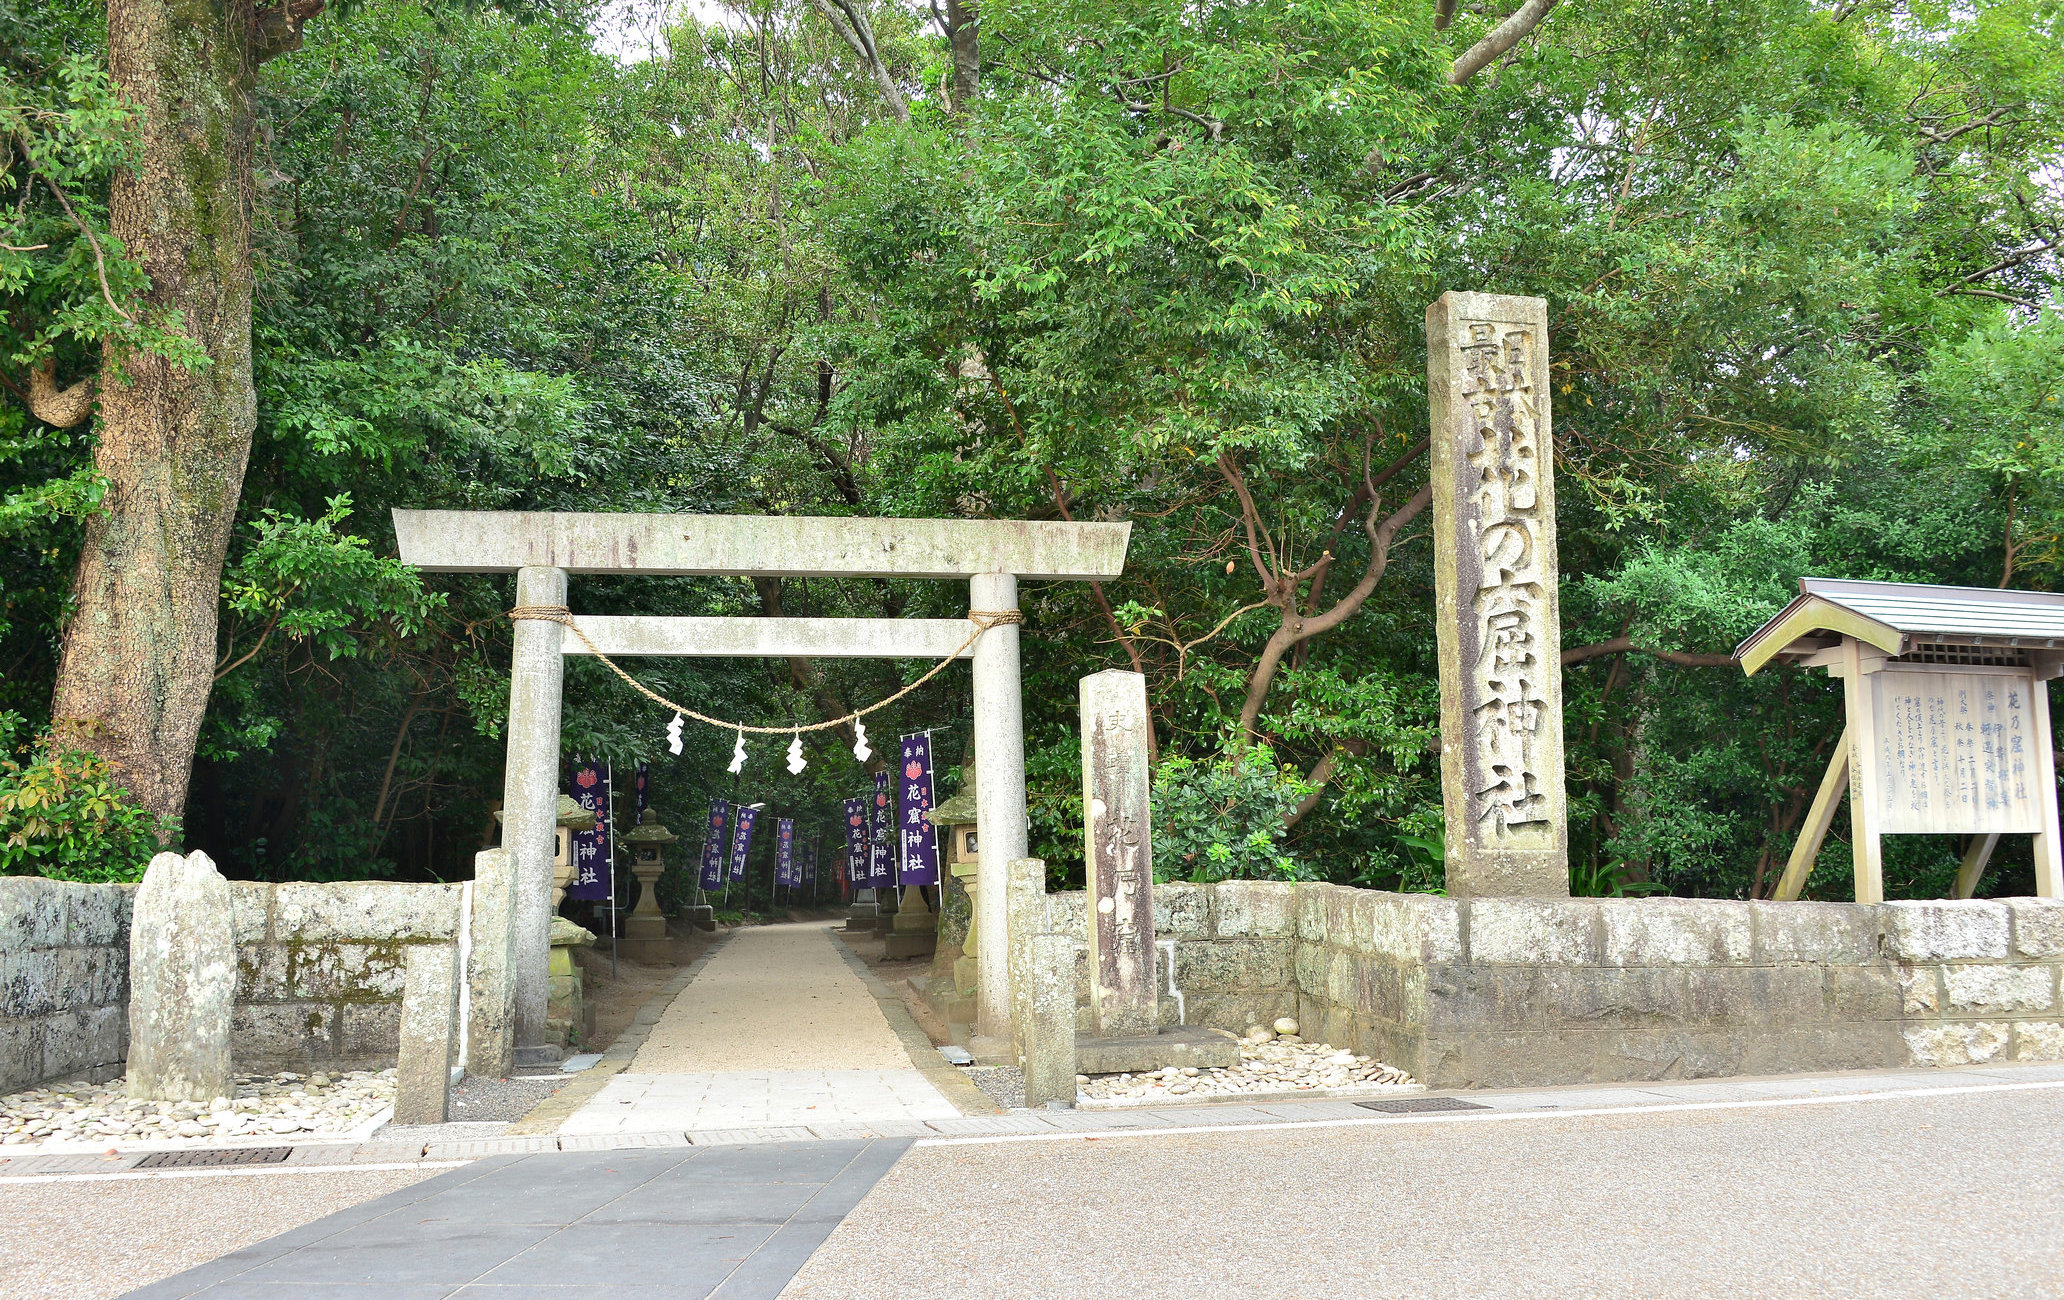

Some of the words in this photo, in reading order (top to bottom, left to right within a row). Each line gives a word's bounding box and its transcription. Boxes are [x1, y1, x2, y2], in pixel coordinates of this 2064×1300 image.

[1460, 322, 1504, 425] 最古
[1502, 331, 1541, 426] 日本
[1467, 426, 1549, 840] 花の窟神社
[579, 792, 599, 886] 花神社
[906, 784, 925, 871] 花窟神社
